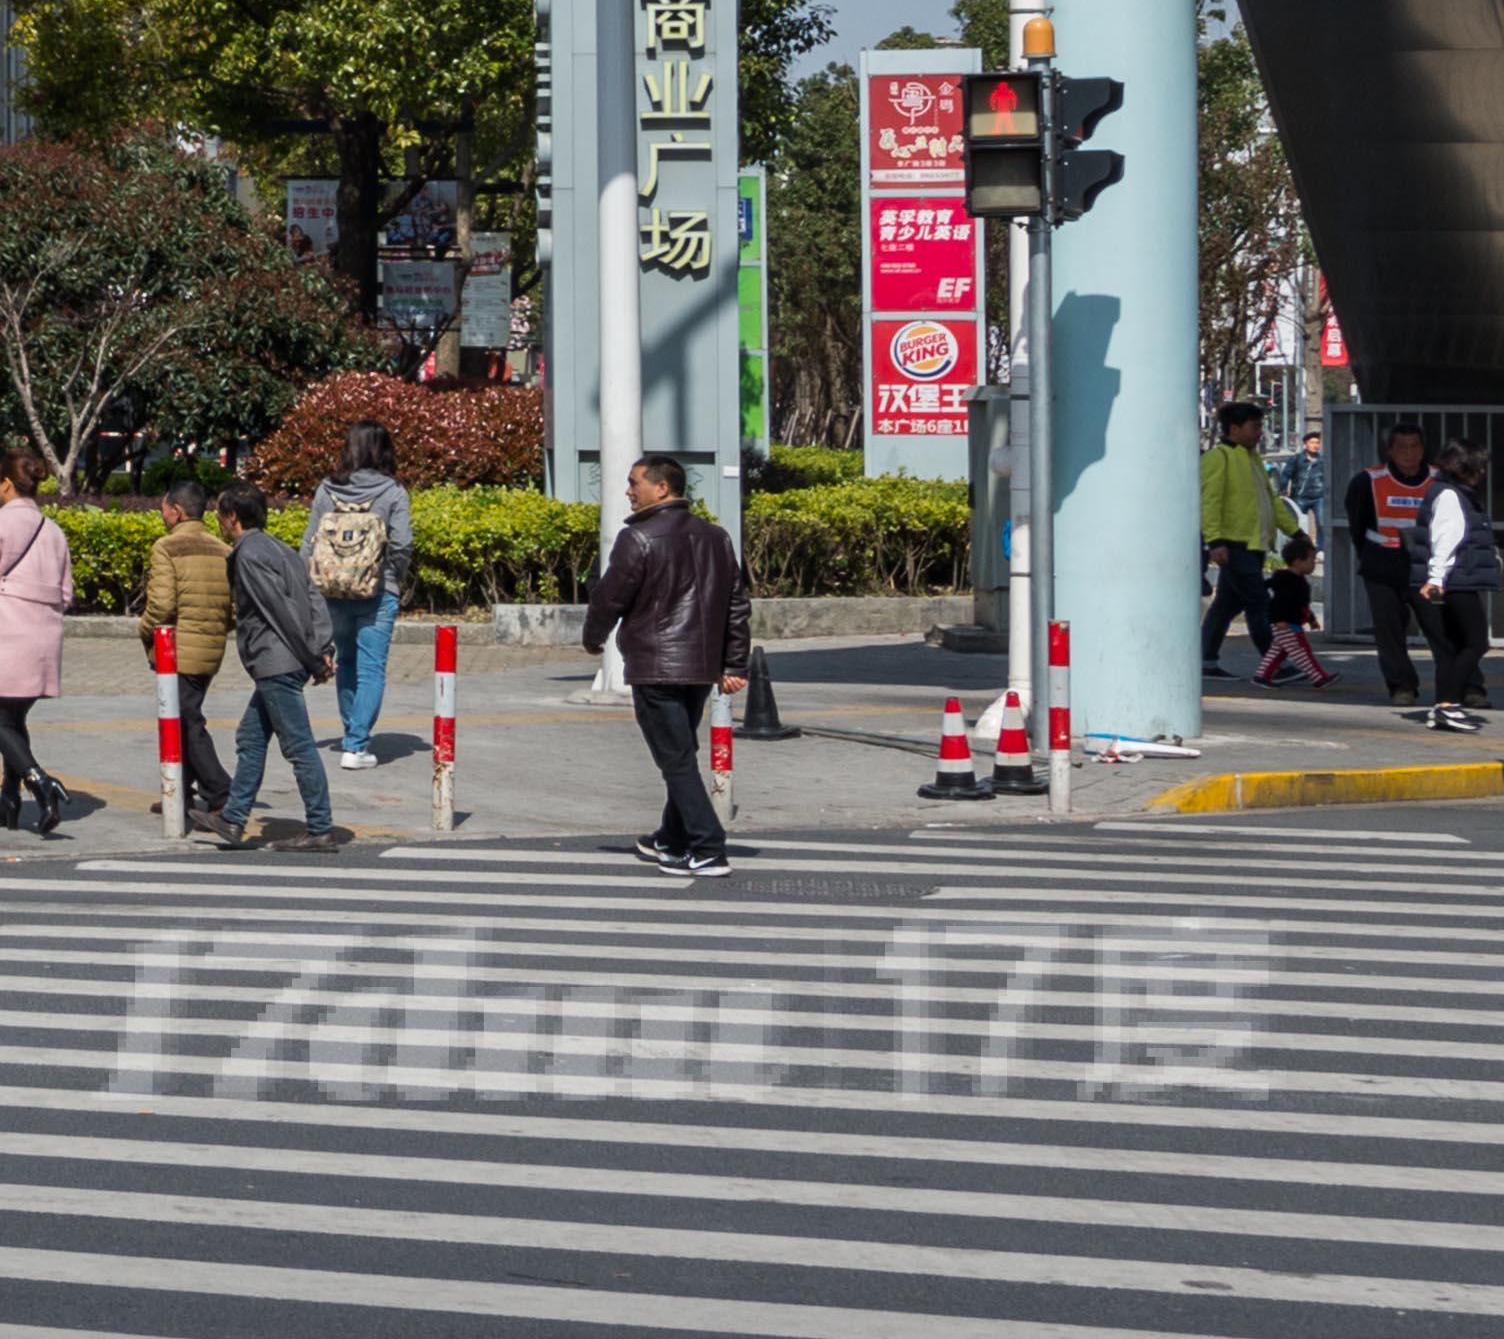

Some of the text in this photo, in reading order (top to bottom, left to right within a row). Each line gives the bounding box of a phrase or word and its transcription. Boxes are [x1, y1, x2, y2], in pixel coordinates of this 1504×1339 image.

[880, 208, 954, 226] 英孚教育
[880, 225, 971, 242] 青少儿英语
[936, 277, 972, 299] EF
[899, 332, 947, 352] BURGER
[901, 343, 950, 366] KING
[878, 383, 969, 414] 汉堡王
